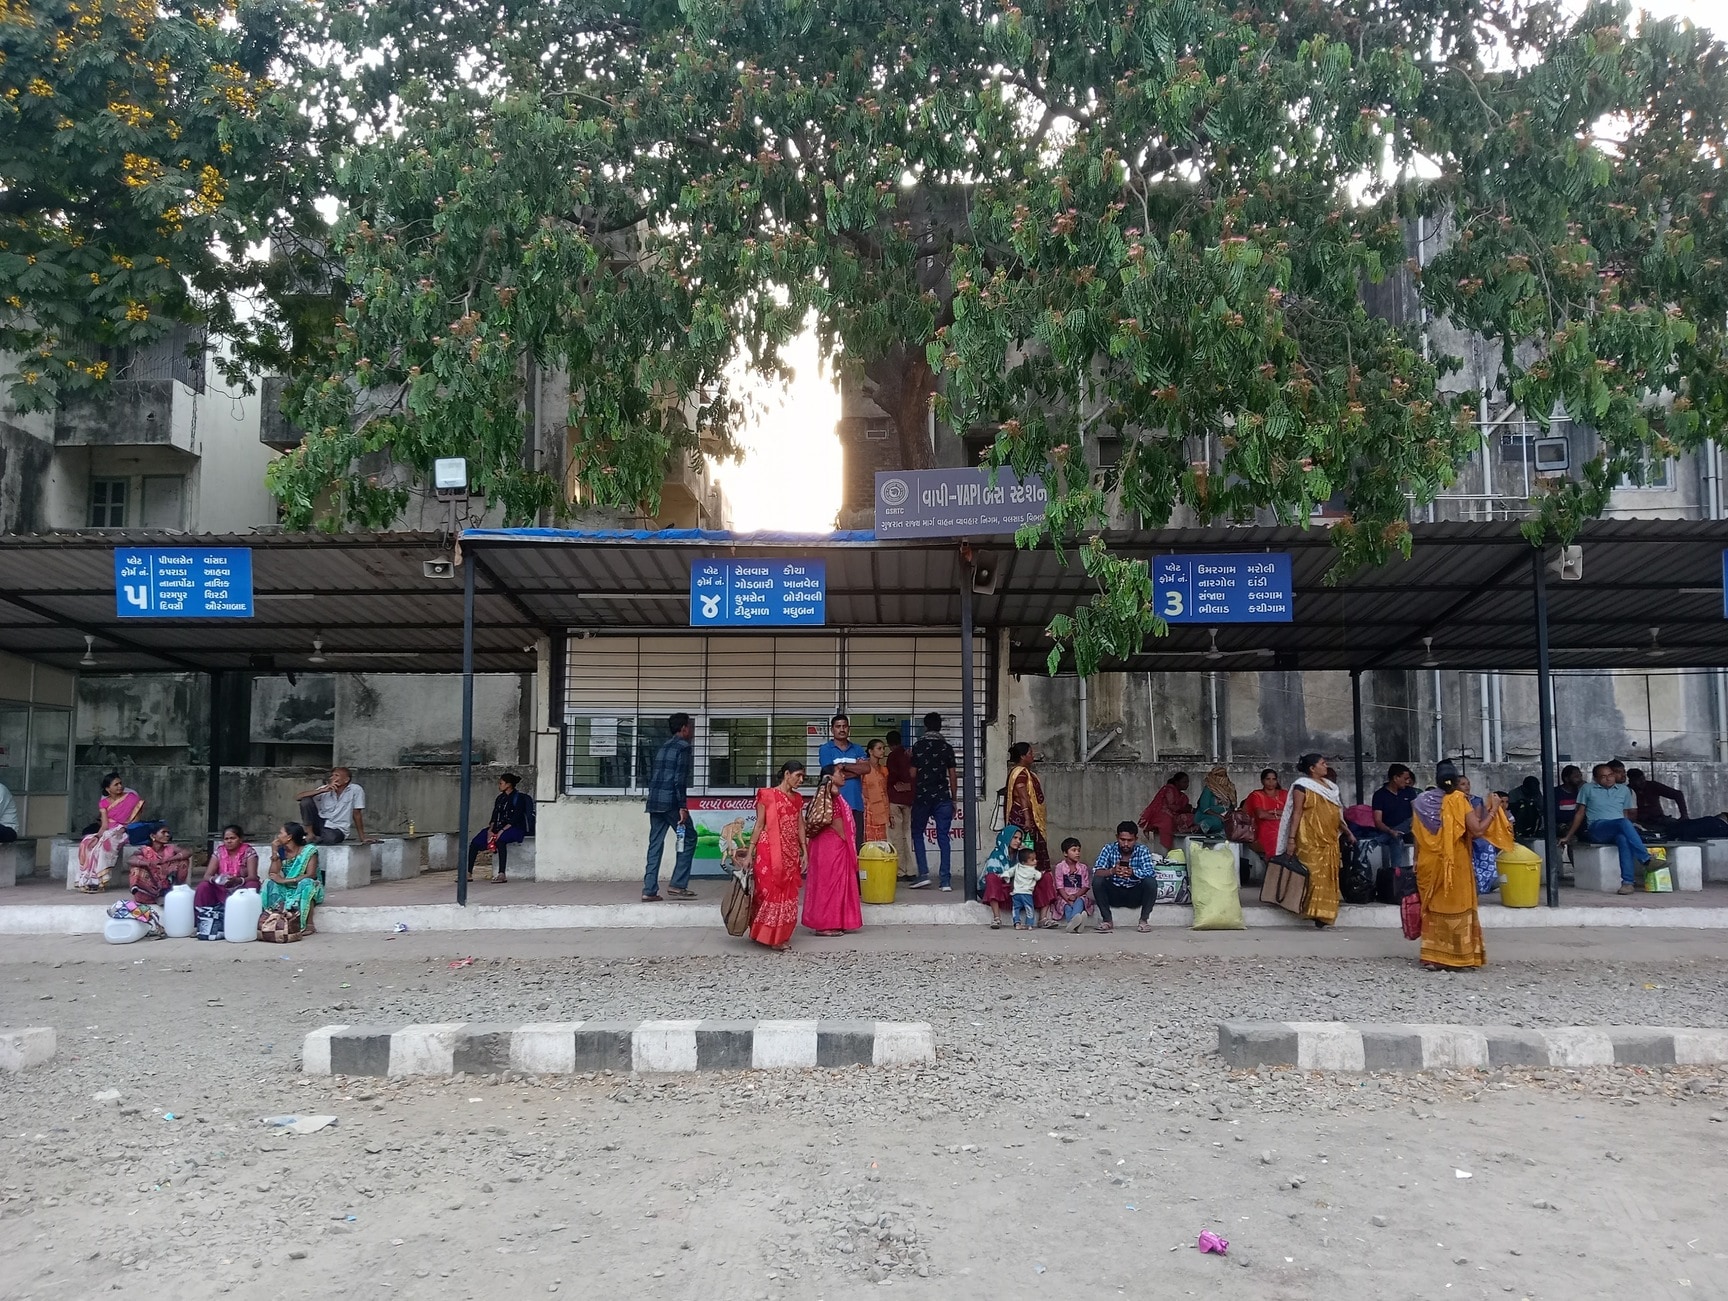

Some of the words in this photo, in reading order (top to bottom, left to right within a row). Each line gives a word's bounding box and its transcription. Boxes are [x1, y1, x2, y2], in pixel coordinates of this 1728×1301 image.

[983, 486, 1004, 505] બસ
[881, 520, 903, 531] ગુજરાત
[922, 517, 935, 527] માર્ગ
[937, 518, 953, 527] વાહન
[956, 517, 978, 526] વ્યવહાર
[1003, 515, 1024, 523] વલસાડ
[127, 555, 142, 565] પ્લેટ
[158, 555, 193, 565] પીપલસેત
[203, 555, 227, 565] વાંસદા
[121, 567, 136, 577] ફોર્મ
[158, 568, 187, 576] કપરાડા
[203, 568, 230, 576] આહવા
[703, 565, 718, 575] પ્લેટ
[734, 565, 769, 576] સેલવાસ
[1165, 563, 1181, 572] પ્લેટ
[1198, 564, 1236, 574] ઉમરગામ
[1247, 562, 1275, 573] મરોલી
[697, 577, 712, 587] ફોર્મ
[734, 578, 773, 589] ગોડબારી
[783, 577, 819, 588] ખાનવેલ
[1159, 574, 1175, 584] ફોર્મ
[1198, 577, 1235, 587] નારગોલ
[1247, 575, 1267, 587] દાંડી
[204, 589, 228, 599] શિરડી
[734, 591, 765, 605] કુમસેત
[783, 591, 822, 602] બોરીવલી
[1198, 590, 1225, 601] સંજાણ
[1247, 591, 1282, 600] કલગામ
[205, 601, 247, 611] ઔરંગાબાદ
[700, 594, 721, 618] ૪
[1198, 604, 1230, 614] ભીલાડ
[1247, 603, 1286, 613] કચીગામ
[734, 606, 769, 619] ટીટુમાળ
[783, 607, 814, 618] મધુબન
